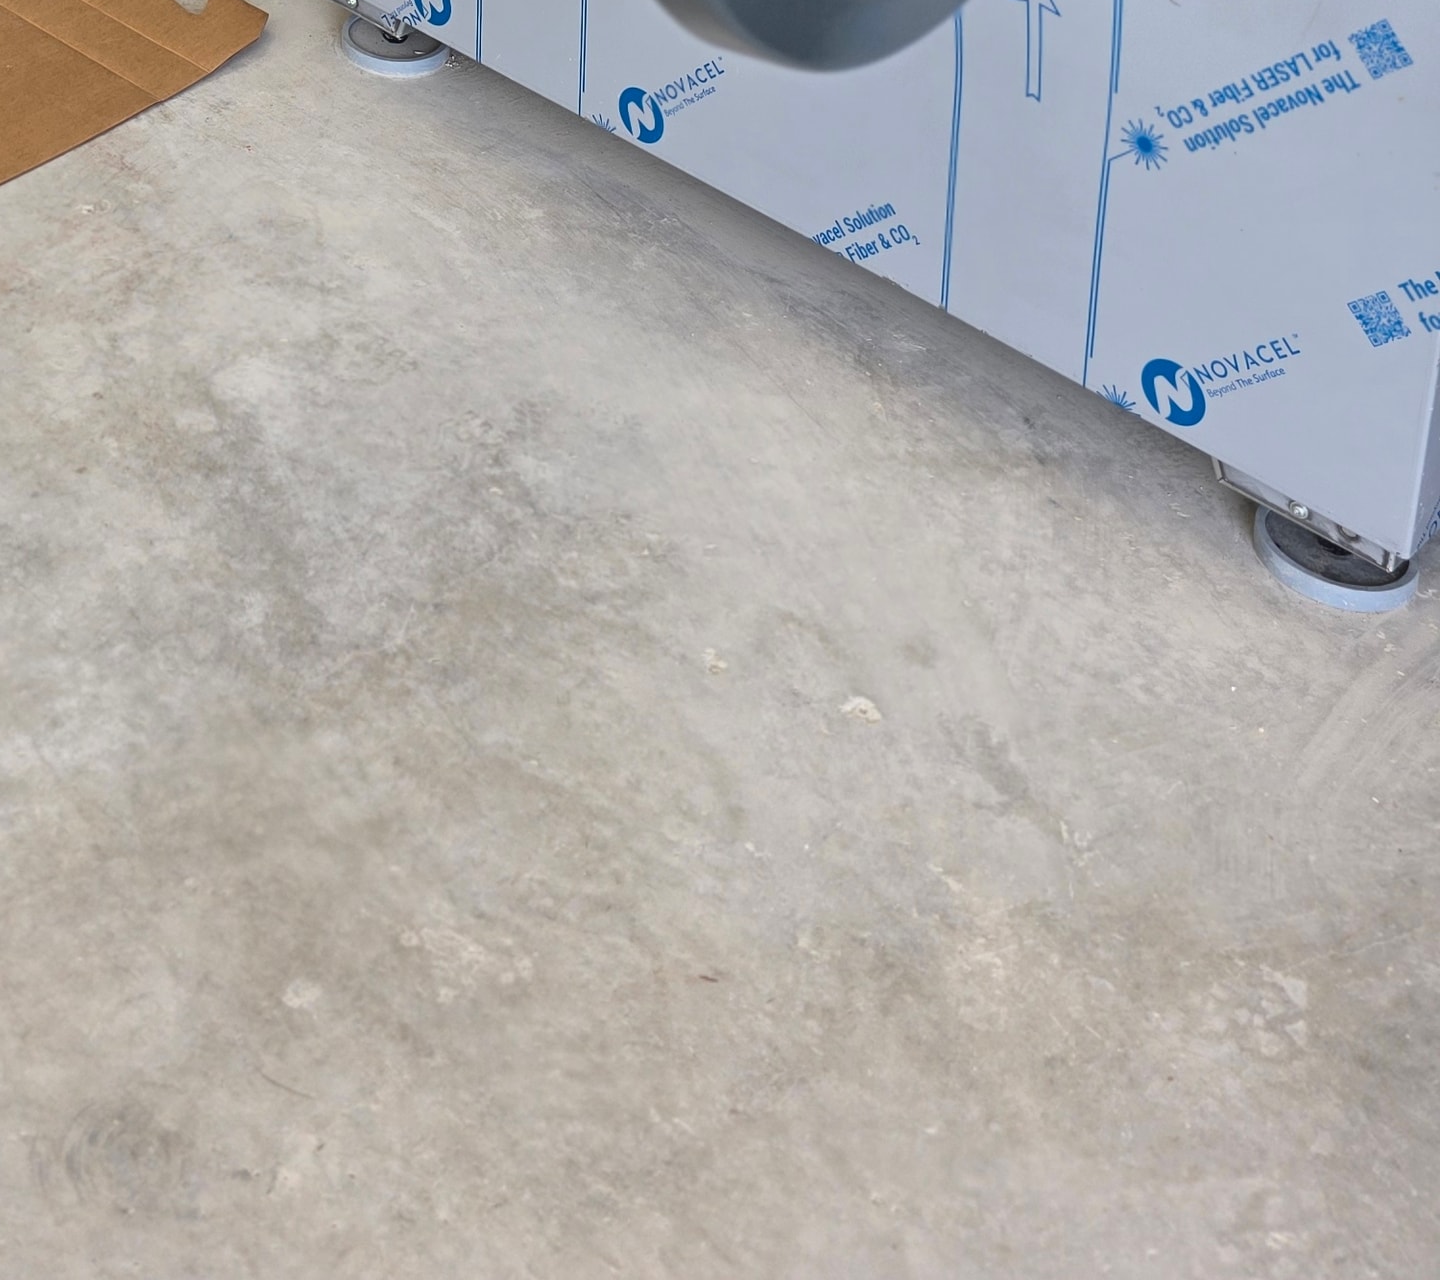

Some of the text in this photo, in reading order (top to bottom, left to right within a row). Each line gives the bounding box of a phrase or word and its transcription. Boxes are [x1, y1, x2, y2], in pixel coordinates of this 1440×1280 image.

[1312, 40, 1341, 63] for
[654, 59, 725, 106] NOVACEL
[1251, 52, 1313, 91] LASER
[664, 86, 716, 117] Beyond The Surface
[1191, 98, 1209, 117] &
[1208, 78, 1254, 107] Fiber
[1183, 70, 1361, 152] The Novacel Solution
[843, 202, 896, 233] Solution
[845, 239, 880, 264] Fiber
[878, 233, 892, 249] &
[1398, 279, 1439, 302] The
[1193, 336, 1301, 384] NOVACEL
[1206, 367, 1285, 398] Beyond The Surface
